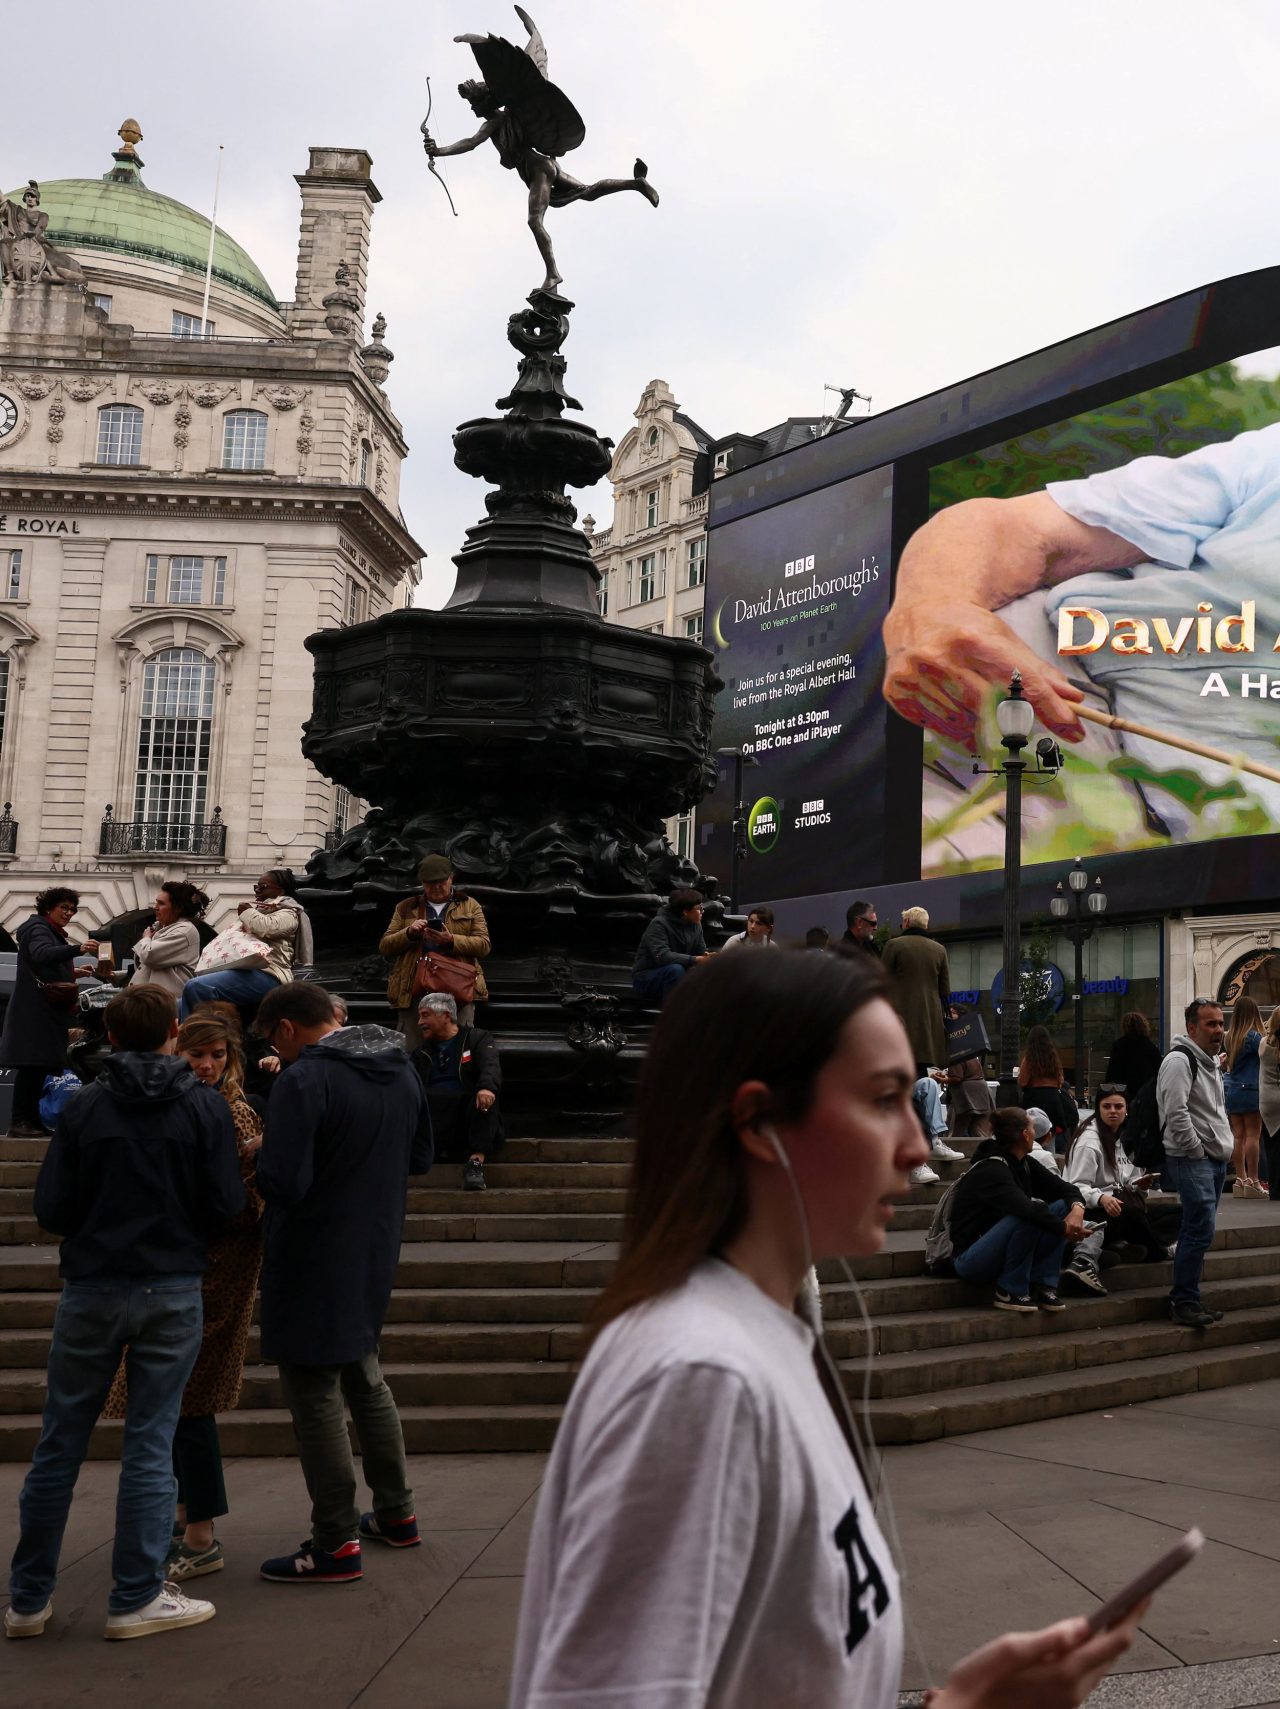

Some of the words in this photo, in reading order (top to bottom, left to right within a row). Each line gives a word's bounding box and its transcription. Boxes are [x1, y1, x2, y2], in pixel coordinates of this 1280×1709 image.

[18, 518, 80, 534] ROYAL
[785, 555, 815, 578] BBC
[734, 589, 771, 624] David
[774, 556, 879, 611] Attenborough's
[760, 619, 771, 631] 100
[772, 615, 789, 628] Years
[790, 613, 798, 623] on
[800, 605, 818, 620] Planet
[820, 602, 837, 615] Earth
[1056, 600, 1257, 656] David
[737, 677, 754, 692] Join
[755, 676, 765, 687] us
[766, 671, 778, 684] for
[779, 672, 785, 680] a
[786, 662, 815, 682] special
[816, 652, 852, 673] evening,
[733, 695, 747, 709] live
[749, 690, 768, 705] from
[769, 686, 782, 700] the
[784, 680, 806, 700] Royal
[809, 672, 836, 690] Albert
[838, 666, 856, 683] Hall
[1199, 673, 1231, 697] A
[754, 718, 785, 736] Tonight
[786, 716, 796, 727] at
[797, 709, 829, 726] 8.30pm
[742, 743, 754, 756] On
[756, 737, 774, 752] BBC
[775, 734, 792, 748] One
[793, 730, 809, 743] and
[811, 722, 842, 742] iPlayer
[802, 799, 824, 814] BBC
[753, 822, 776, 836] EARTH
[794, 812, 831, 829] STUDIOS
[50, 863, 137, 873] ALLIANCE
[1082, 976, 1129, 996] beauty
[294, 1554, 316, 1574] N
[834, 1498, 890, 1656] A
